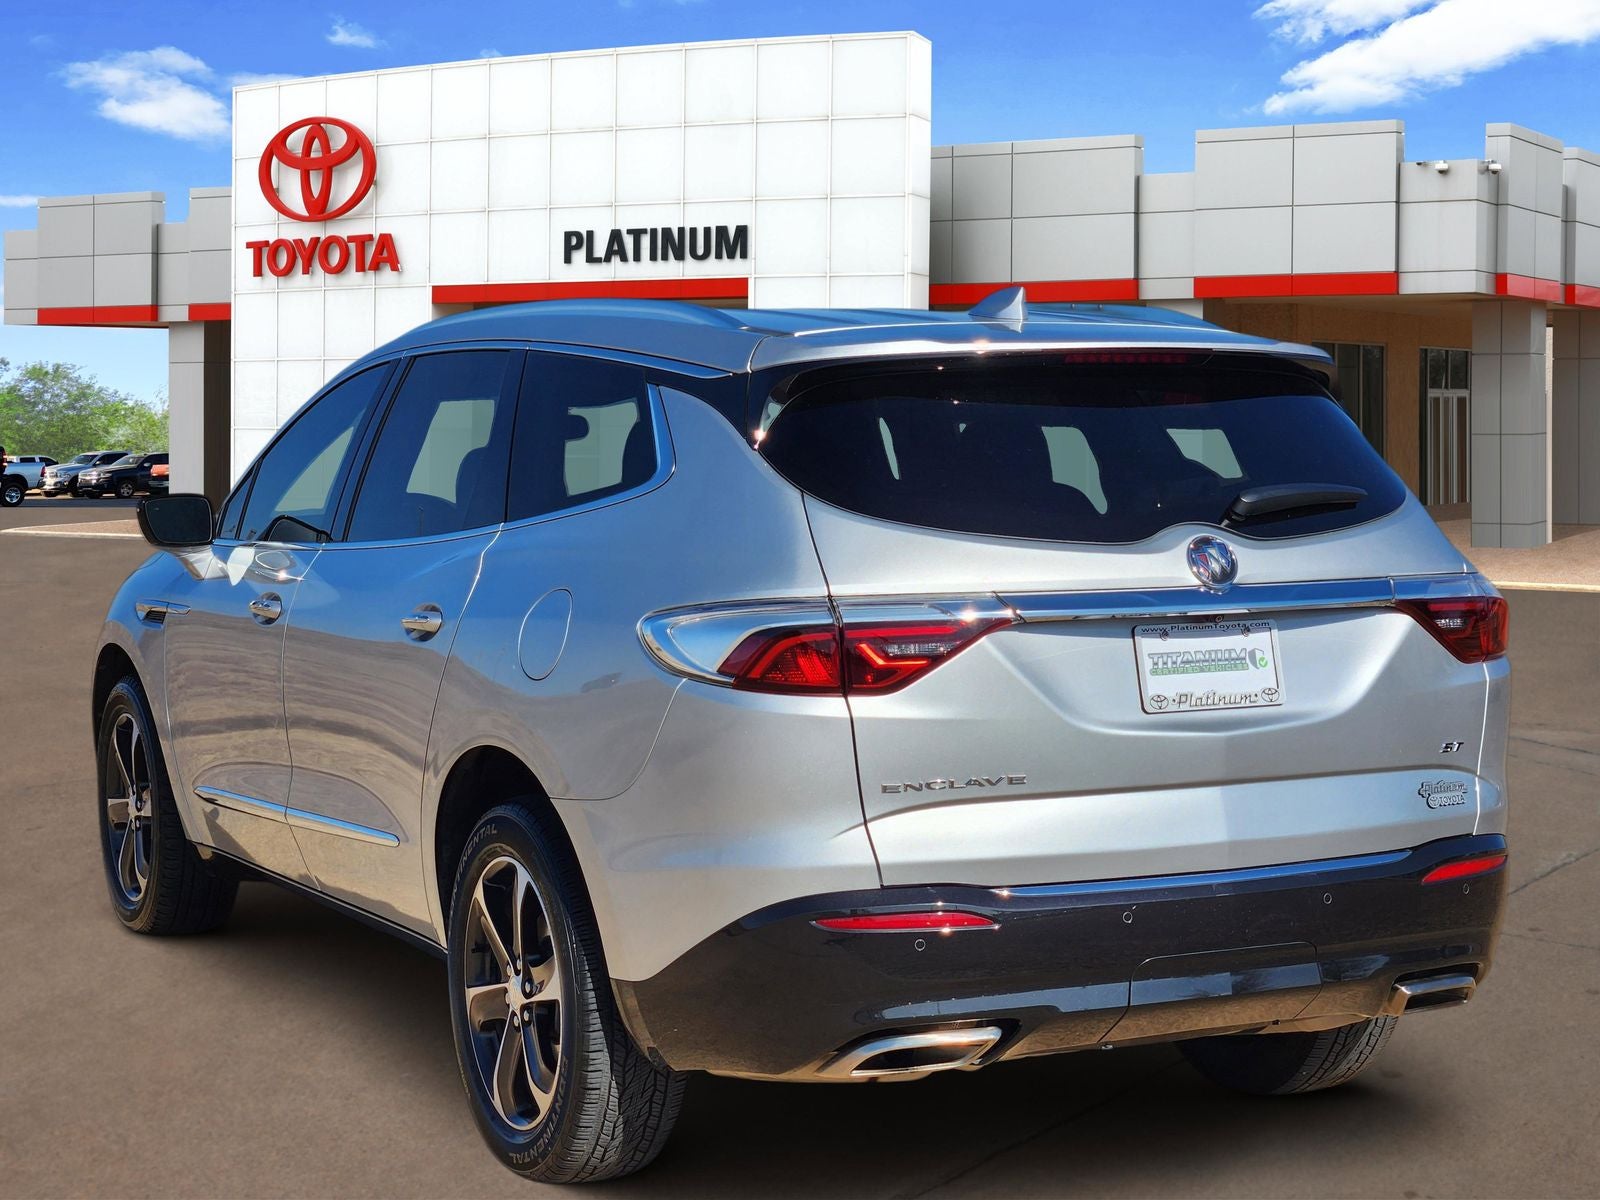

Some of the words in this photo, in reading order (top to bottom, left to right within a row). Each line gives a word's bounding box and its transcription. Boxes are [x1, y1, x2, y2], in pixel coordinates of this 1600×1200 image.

[564, 225, 748, 264] PLATINUM
[246, 233, 401, 277] TOYOTA
[1141, 621, 1270, 633] www.PlatinumToyota.com
[1148, 648, 1248, 668] TITANIUM
[1150, 666, 1200, 676] CERTIFIED
[1202, 663, 1249, 672] VEHICLES
[1176, 690, 1257, 708] Platinum
[1440, 742, 1464, 753] ST
[881, 774, 1027, 794] ENCLAVE
[1439, 794, 1466, 806] TOYOTA
